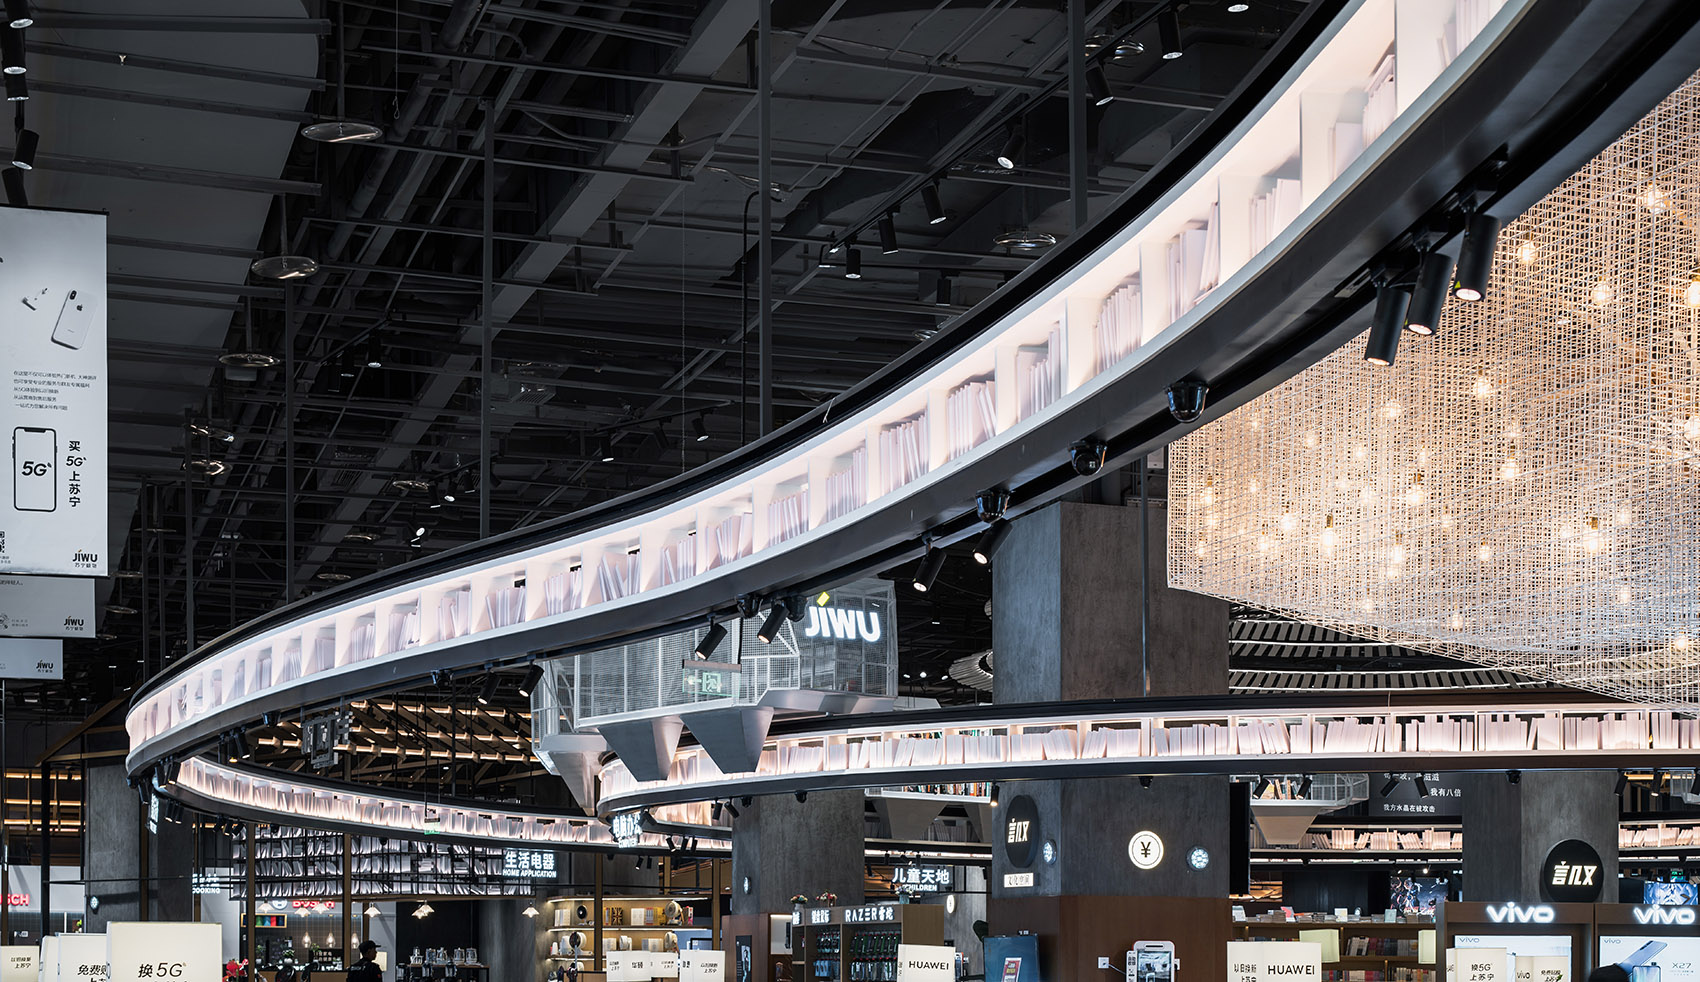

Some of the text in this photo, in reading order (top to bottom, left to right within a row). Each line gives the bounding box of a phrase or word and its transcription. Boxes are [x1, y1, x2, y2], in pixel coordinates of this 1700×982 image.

[21, 460, 48, 476] 5G
[1430, 788, 1462, 797] 我有八倍
[1383, 804, 1436, 813] 我方水晶在被攻击
[504, 850, 554, 871] 生活电器
[502, 869, 557, 878] HOME APPLICATION
[892, 867, 950, 885] 儿童天地
[845, 907, 878, 923] RAZER
[1486, 902, 1556, 923] vivo
[1633, 904, 1696, 924] vivo
[908, 960, 950, 971] HUAWEI
[1267, 964, 1315, 975] HUAWEI
[1516, 971, 1531, 979] vivo
